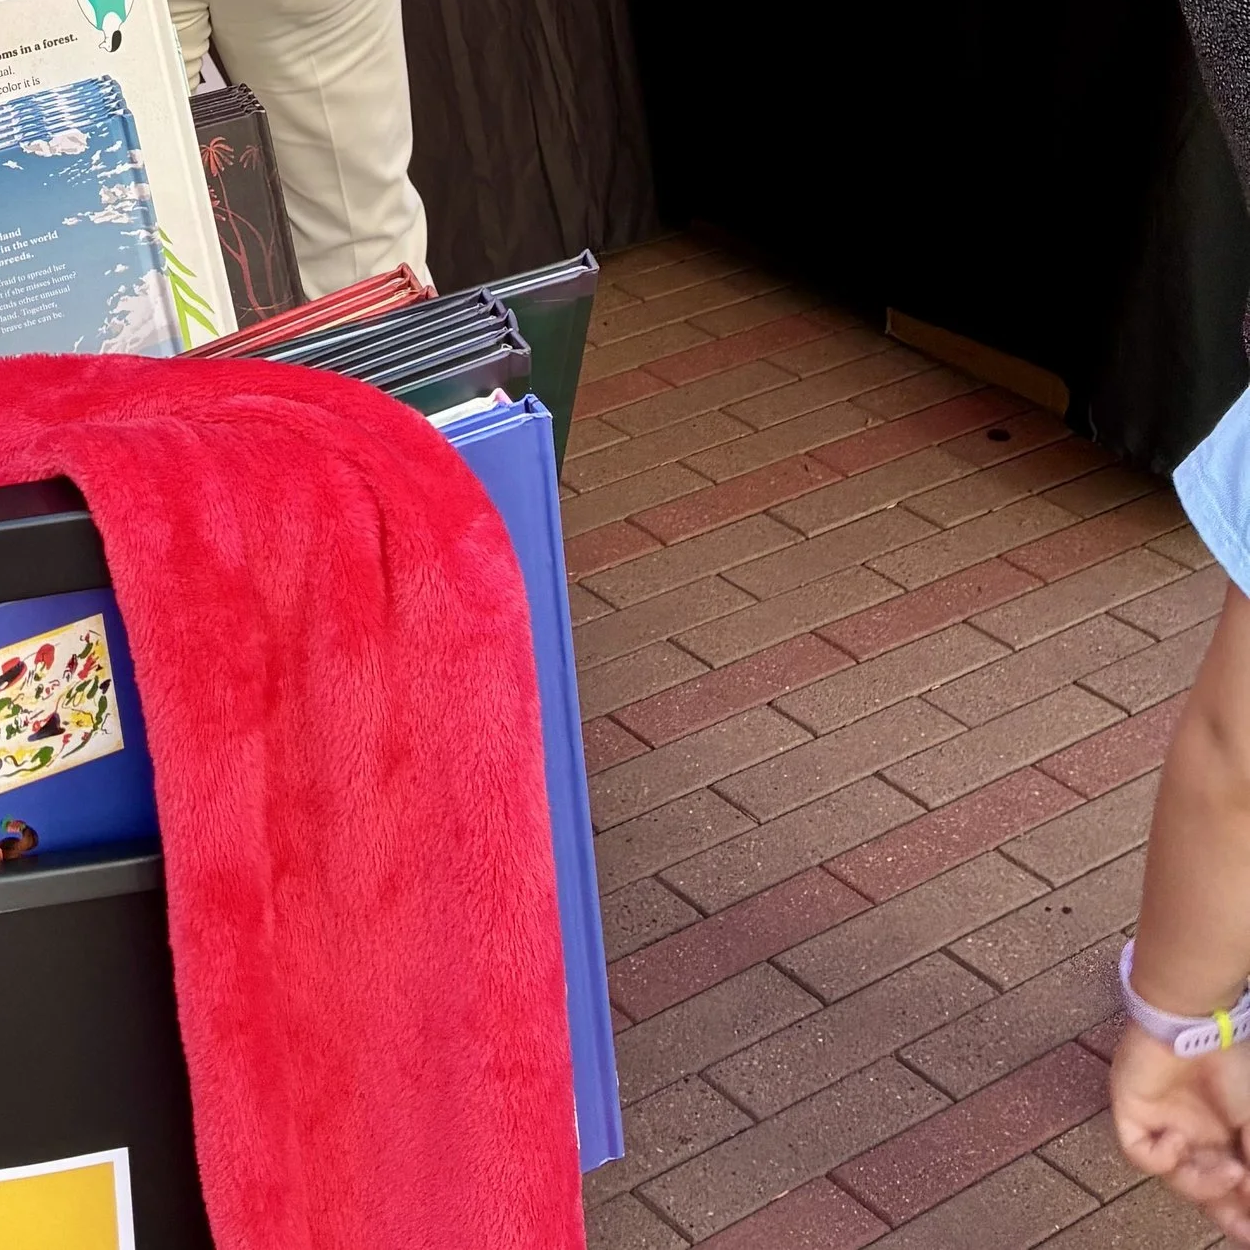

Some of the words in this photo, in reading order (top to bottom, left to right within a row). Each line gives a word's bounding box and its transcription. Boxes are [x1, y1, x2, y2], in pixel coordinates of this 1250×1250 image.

[20, 45, 32, 55] in
[43, 34, 78, 49] forest.
[24, 80, 31, 88] it
[31, 76, 41, 86] is
[0, 245, 11, 254] in
[12, 241, 28, 251] the
[30, 230, 59, 245] world
[27, 266, 52, 280] spread
[53, 264, 66, 272] her
[5, 289, 10, 298] if
[11, 287, 25, 296] she
[26, 280, 51, 292] misses
[51, 271, 77, 284] home?
[18, 295, 39, 305] other
[40, 284, 71, 299] unusual
[20, 302, 58, 316] Together,
[1, 323, 22, 334] brave
[23, 319, 36, 328] she
[37, 315, 52, 324] can
